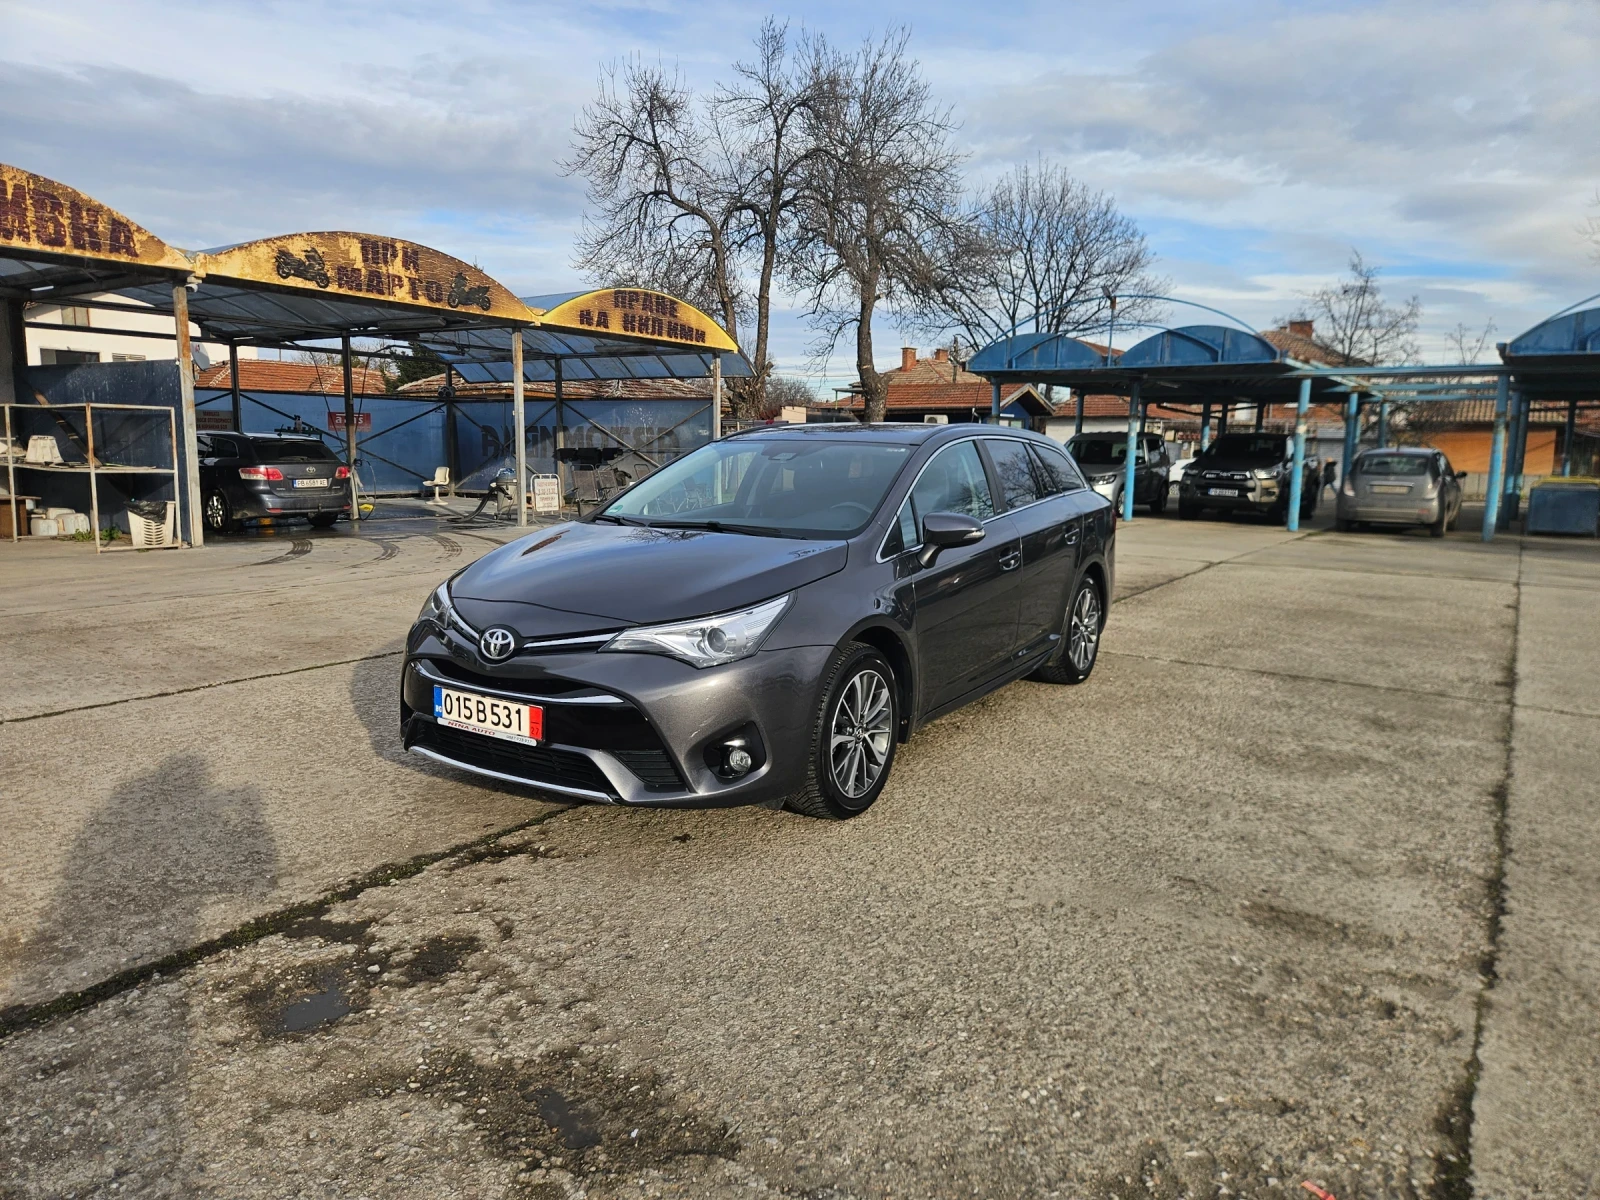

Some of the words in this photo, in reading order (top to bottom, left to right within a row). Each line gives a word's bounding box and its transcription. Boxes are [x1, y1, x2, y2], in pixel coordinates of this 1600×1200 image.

[614, 289, 678, 318] ПРАНЕ
[579, 309, 609, 329] НА
[444, 693, 523, 732] 015B531
[447, 720, 469, 730] NINA
[471, 727, 496, 736] AUTO
